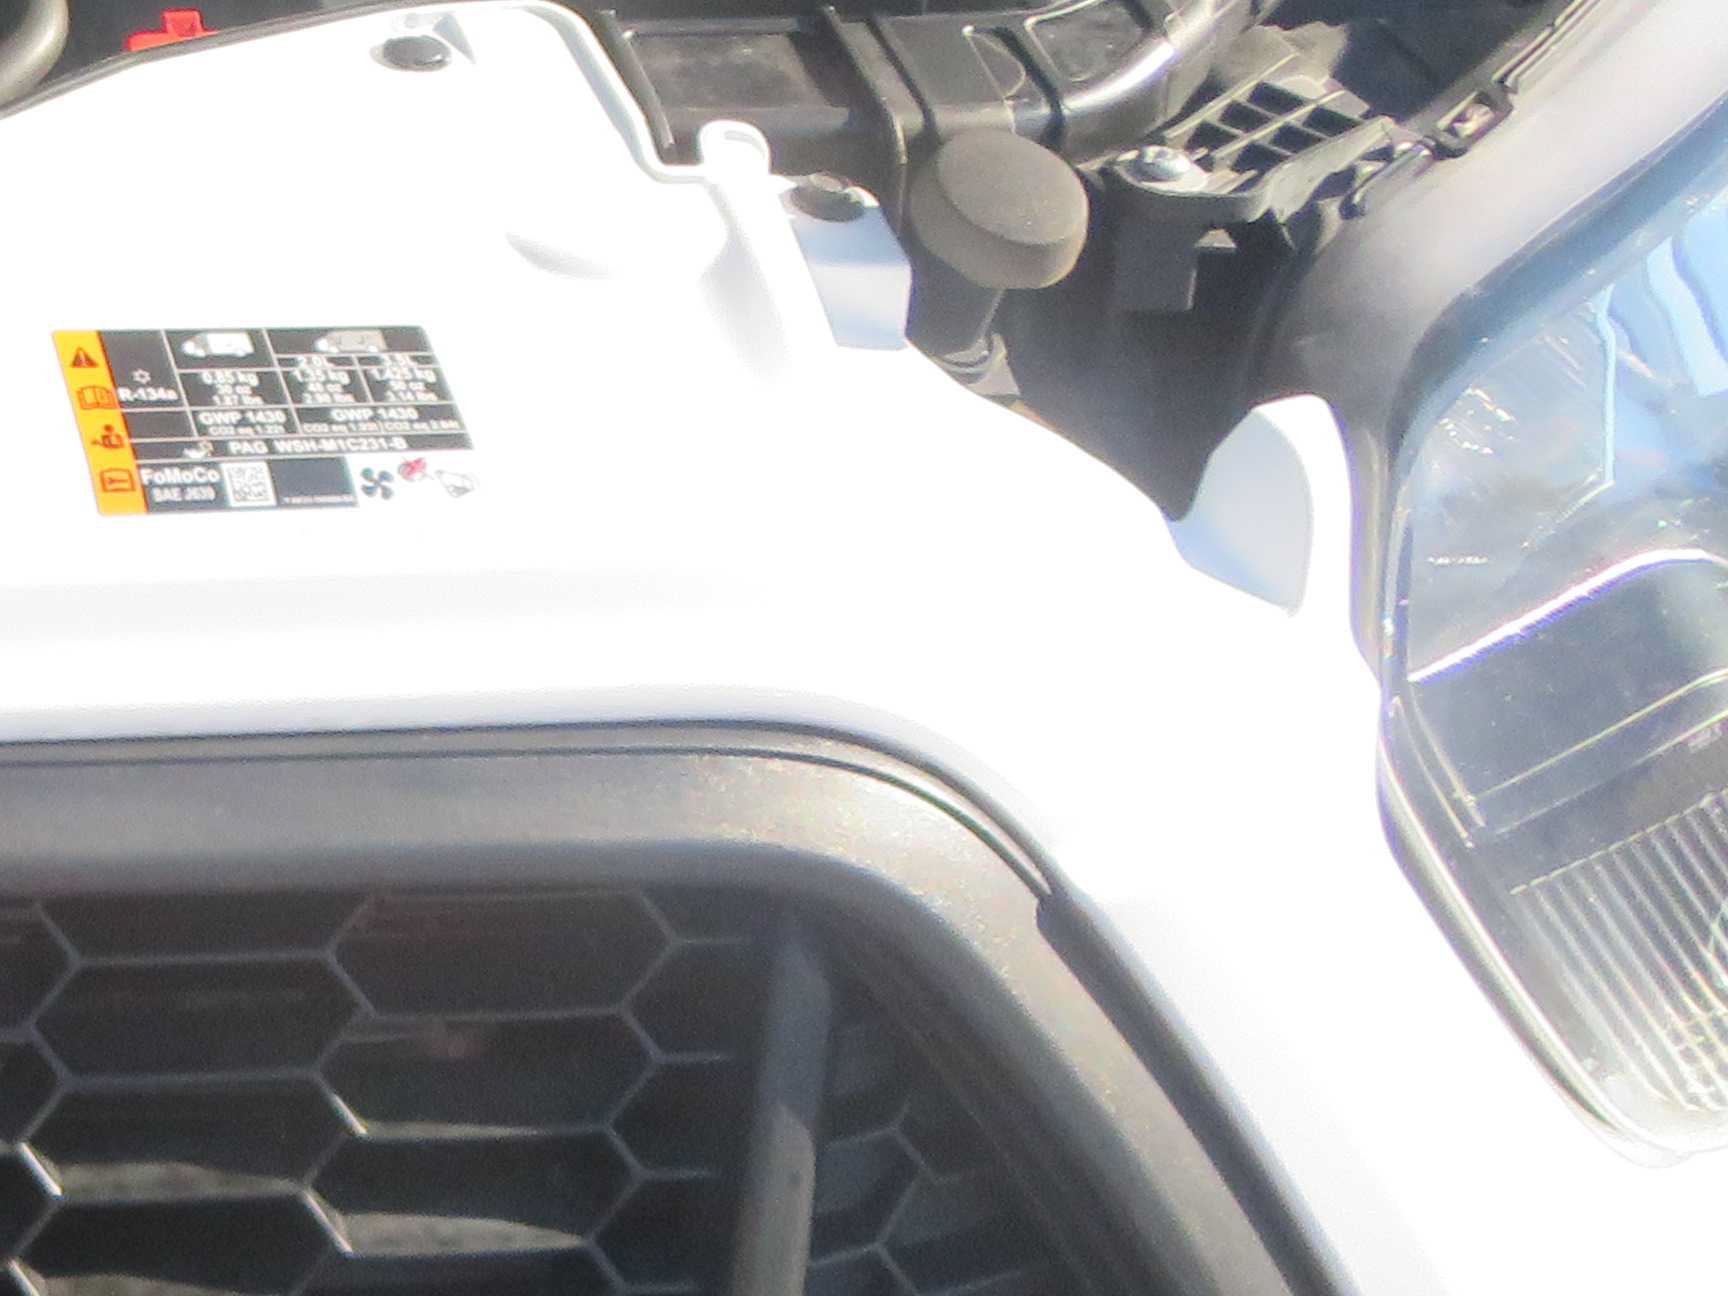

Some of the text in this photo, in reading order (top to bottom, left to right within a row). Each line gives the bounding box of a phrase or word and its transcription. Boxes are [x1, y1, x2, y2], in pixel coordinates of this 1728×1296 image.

[116, 386, 179, 402] R-134a
[198, 409, 287, 426] GWP 1430
[330, 407, 418, 422] GWP 1430
[228, 436, 407, 455] PAG WSH-M1C231-B
[139, 466, 221, 486] FoMoCo
